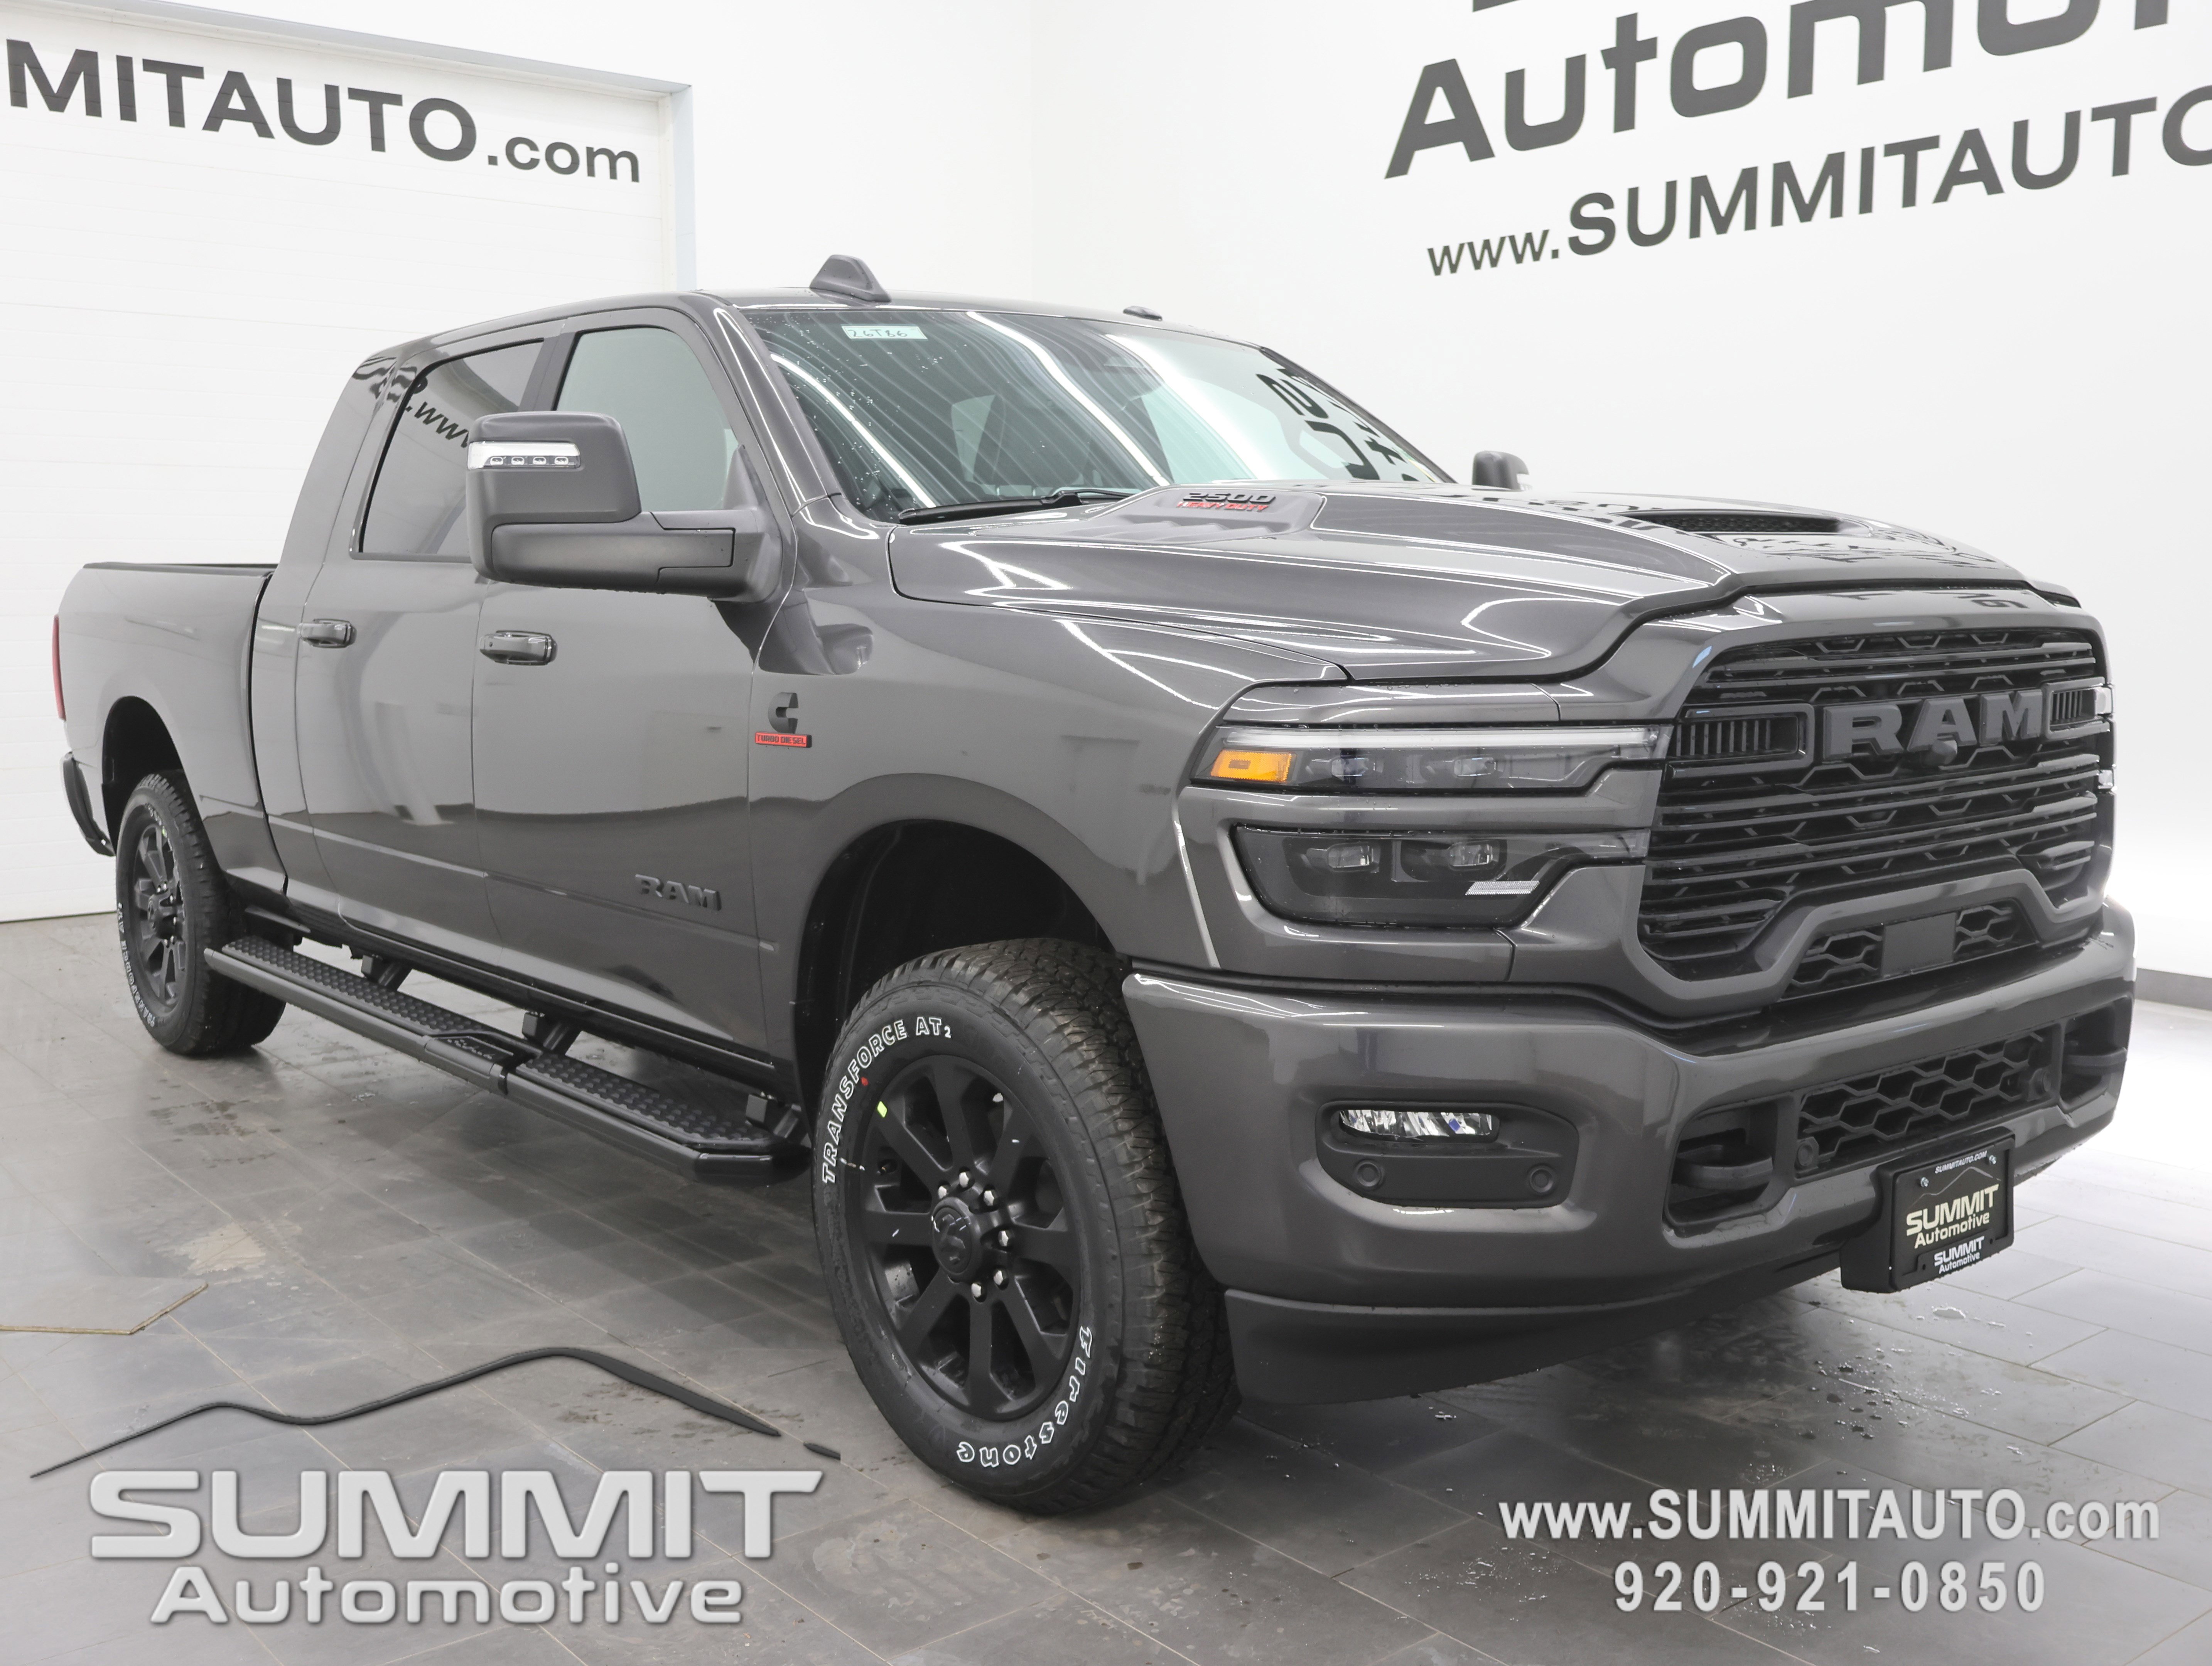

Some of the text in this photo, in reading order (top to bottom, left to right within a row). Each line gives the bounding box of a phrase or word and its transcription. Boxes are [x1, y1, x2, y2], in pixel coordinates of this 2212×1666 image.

[7, 39, 640, 183] MITAUTO.com
[1183, 493, 1276, 504] 2500
[1225, 502, 1269, 512] DUTY
[756, 734, 806, 745] TURBO DIESEL
[1823, 689, 2043, 760] RAM
[635, 873, 722, 911] RAM
[822, 1020, 907, 1183] TRANSFORCE
[1906, 1184, 1999, 1236] SUMMIT
[1914, 1212, 1990, 1249] Automotive
[1934, 1236, 1985, 1266] SUMMIT
[1939, 1252, 1980, 1274] Automotive
[957, 1326, 1092, 1467] Firestone
